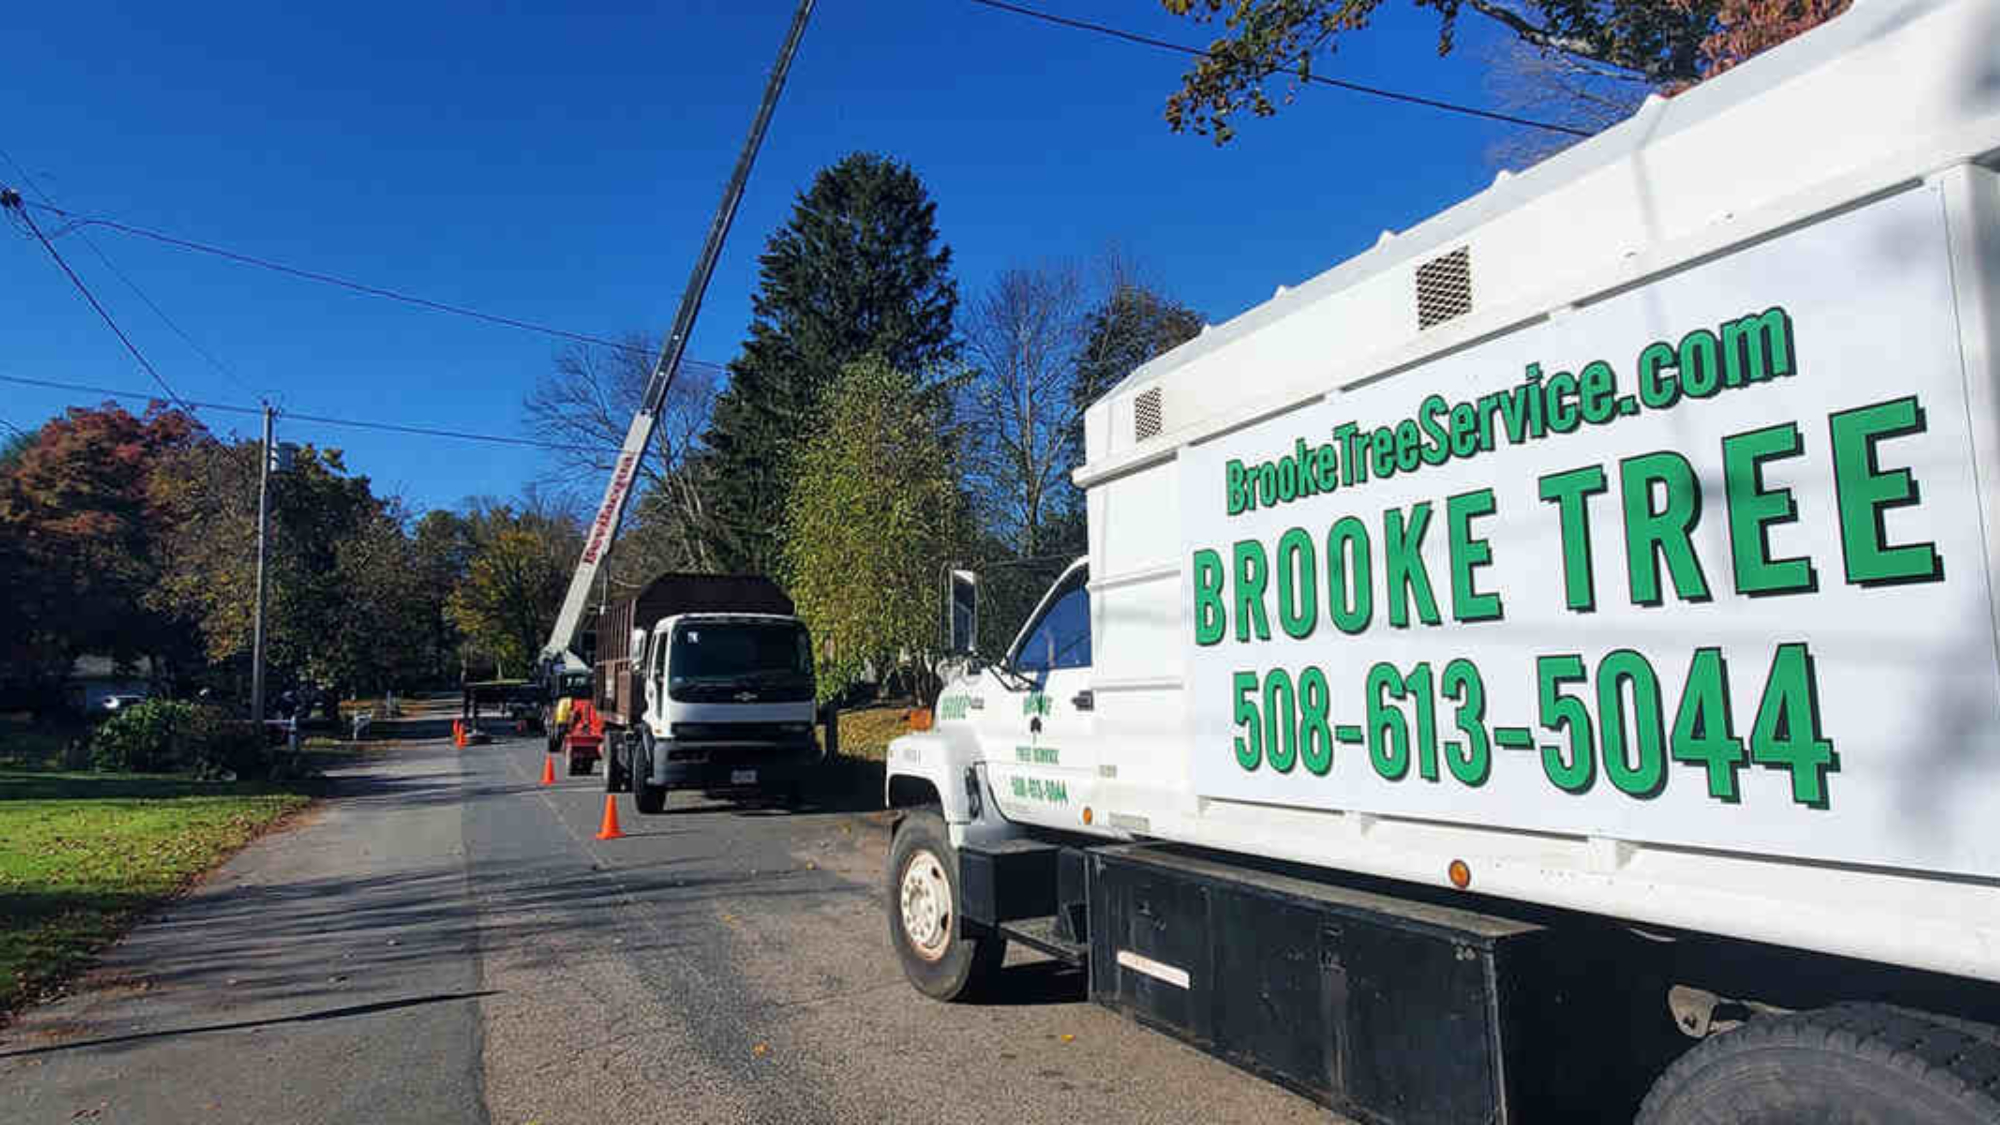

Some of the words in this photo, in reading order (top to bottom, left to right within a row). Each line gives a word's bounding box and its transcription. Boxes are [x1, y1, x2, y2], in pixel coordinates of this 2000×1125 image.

[1225, 306, 1797, 516] BrookeTreeService.com
[1193, 488, 1504, 648] BROOKE
[1538, 395, 1946, 614] TREE
[1233, 641, 1841, 811] 508-613-5044
